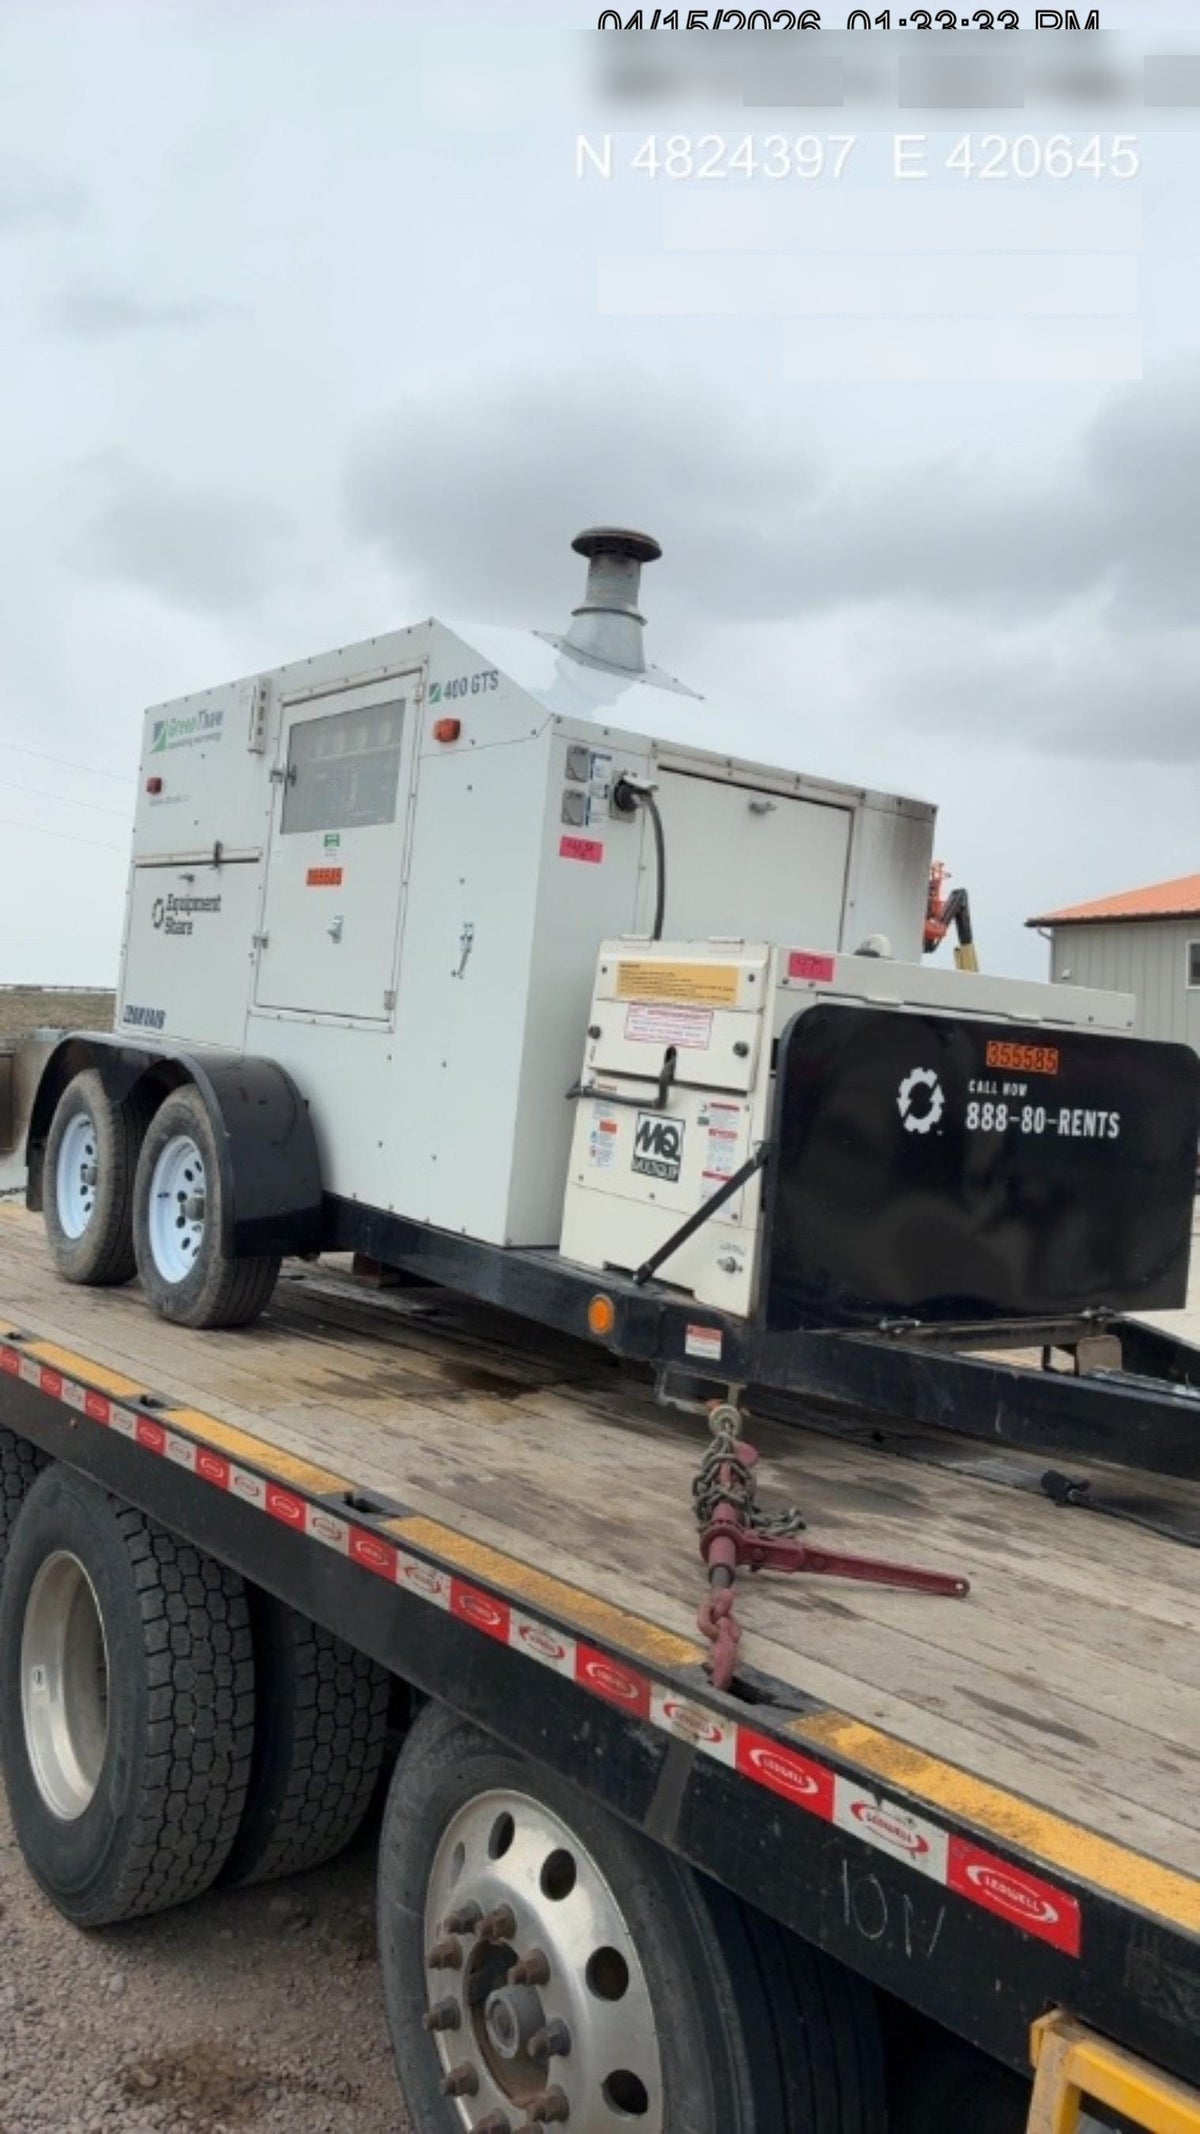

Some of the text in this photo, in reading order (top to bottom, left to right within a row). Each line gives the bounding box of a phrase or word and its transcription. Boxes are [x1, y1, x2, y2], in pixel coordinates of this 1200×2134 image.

[443, 670, 499, 699] 400 GTS
[166, 893, 221, 916] Equipment
[968, 1079, 1028, 1097] CALL NOW
[965, 1102, 1121, 1138] 888-80-RENTS
[635, 1120, 681, 1161] MQ
[985, 1876, 1040, 1913] LEDWELL
